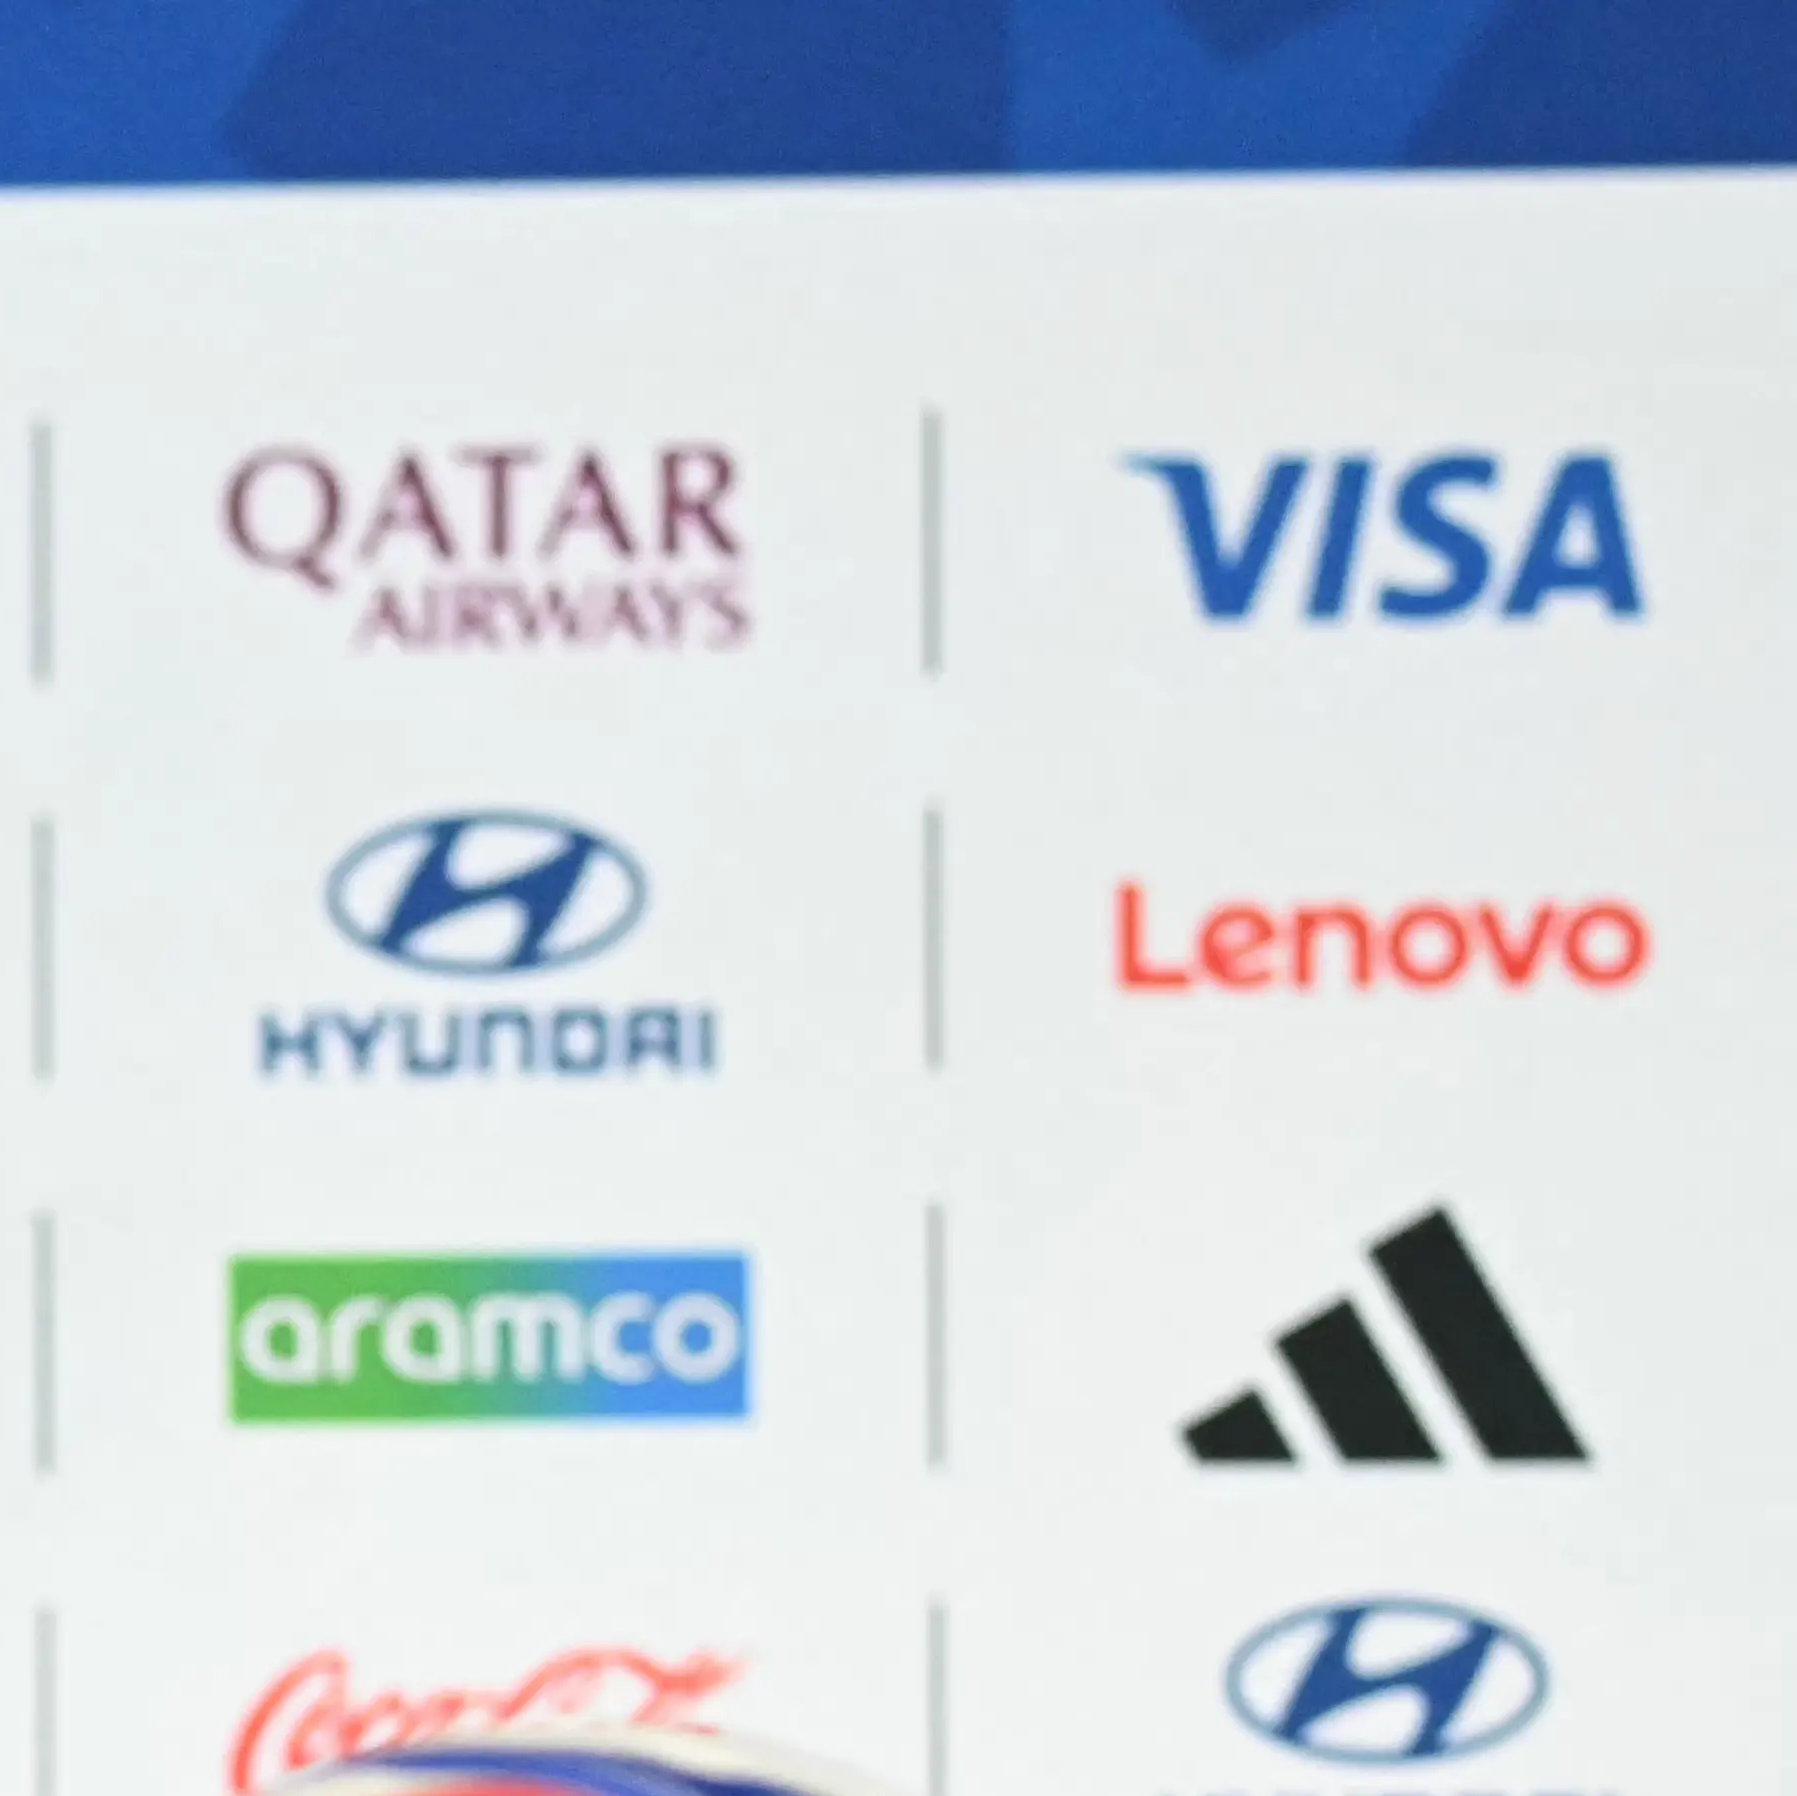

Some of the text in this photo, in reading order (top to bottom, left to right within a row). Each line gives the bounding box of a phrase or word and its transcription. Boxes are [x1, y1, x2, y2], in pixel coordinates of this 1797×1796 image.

[223, 447, 740, 567] QATAR
[1125, 450, 1643, 622] VISA
[350, 575, 753, 652] AIRWAYS
[1115, 882, 1650, 993] Lenovo
[260, 1006, 716, 1078] HYUNDAI
[238, 1294, 740, 1383] aramco
